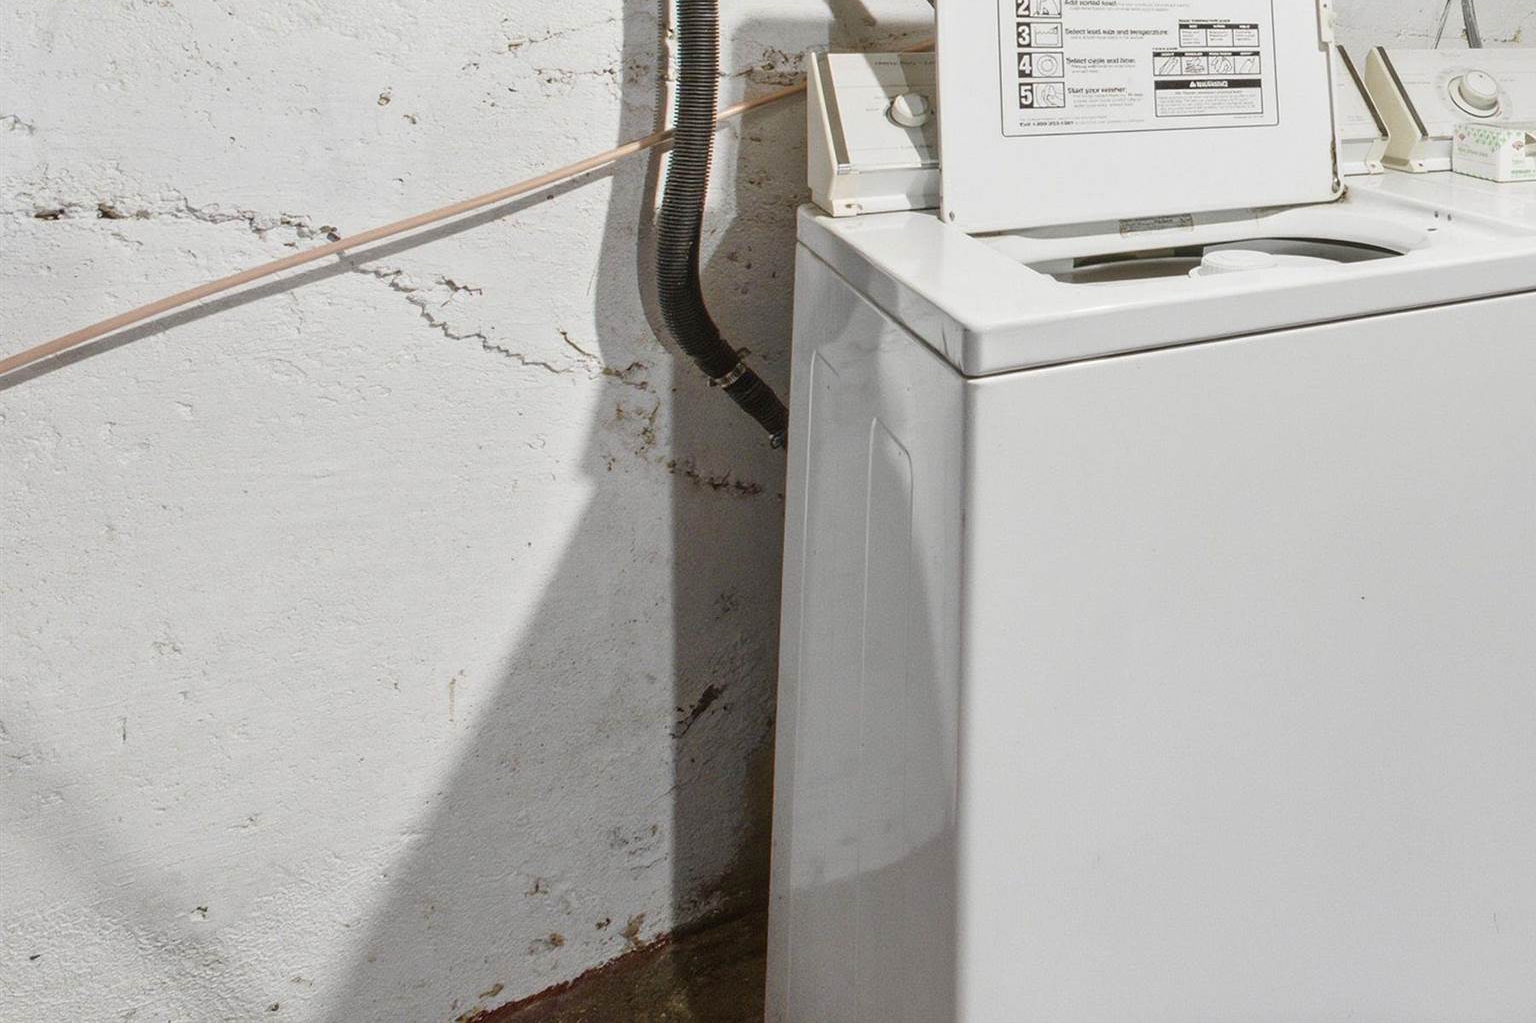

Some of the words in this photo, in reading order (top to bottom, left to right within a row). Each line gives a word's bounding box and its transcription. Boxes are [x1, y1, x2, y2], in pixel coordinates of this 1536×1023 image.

[1018, 25, 1030, 45] 3
[1019, 54, 1032, 75] 4
[1020, 84, 1032, 105] 5
